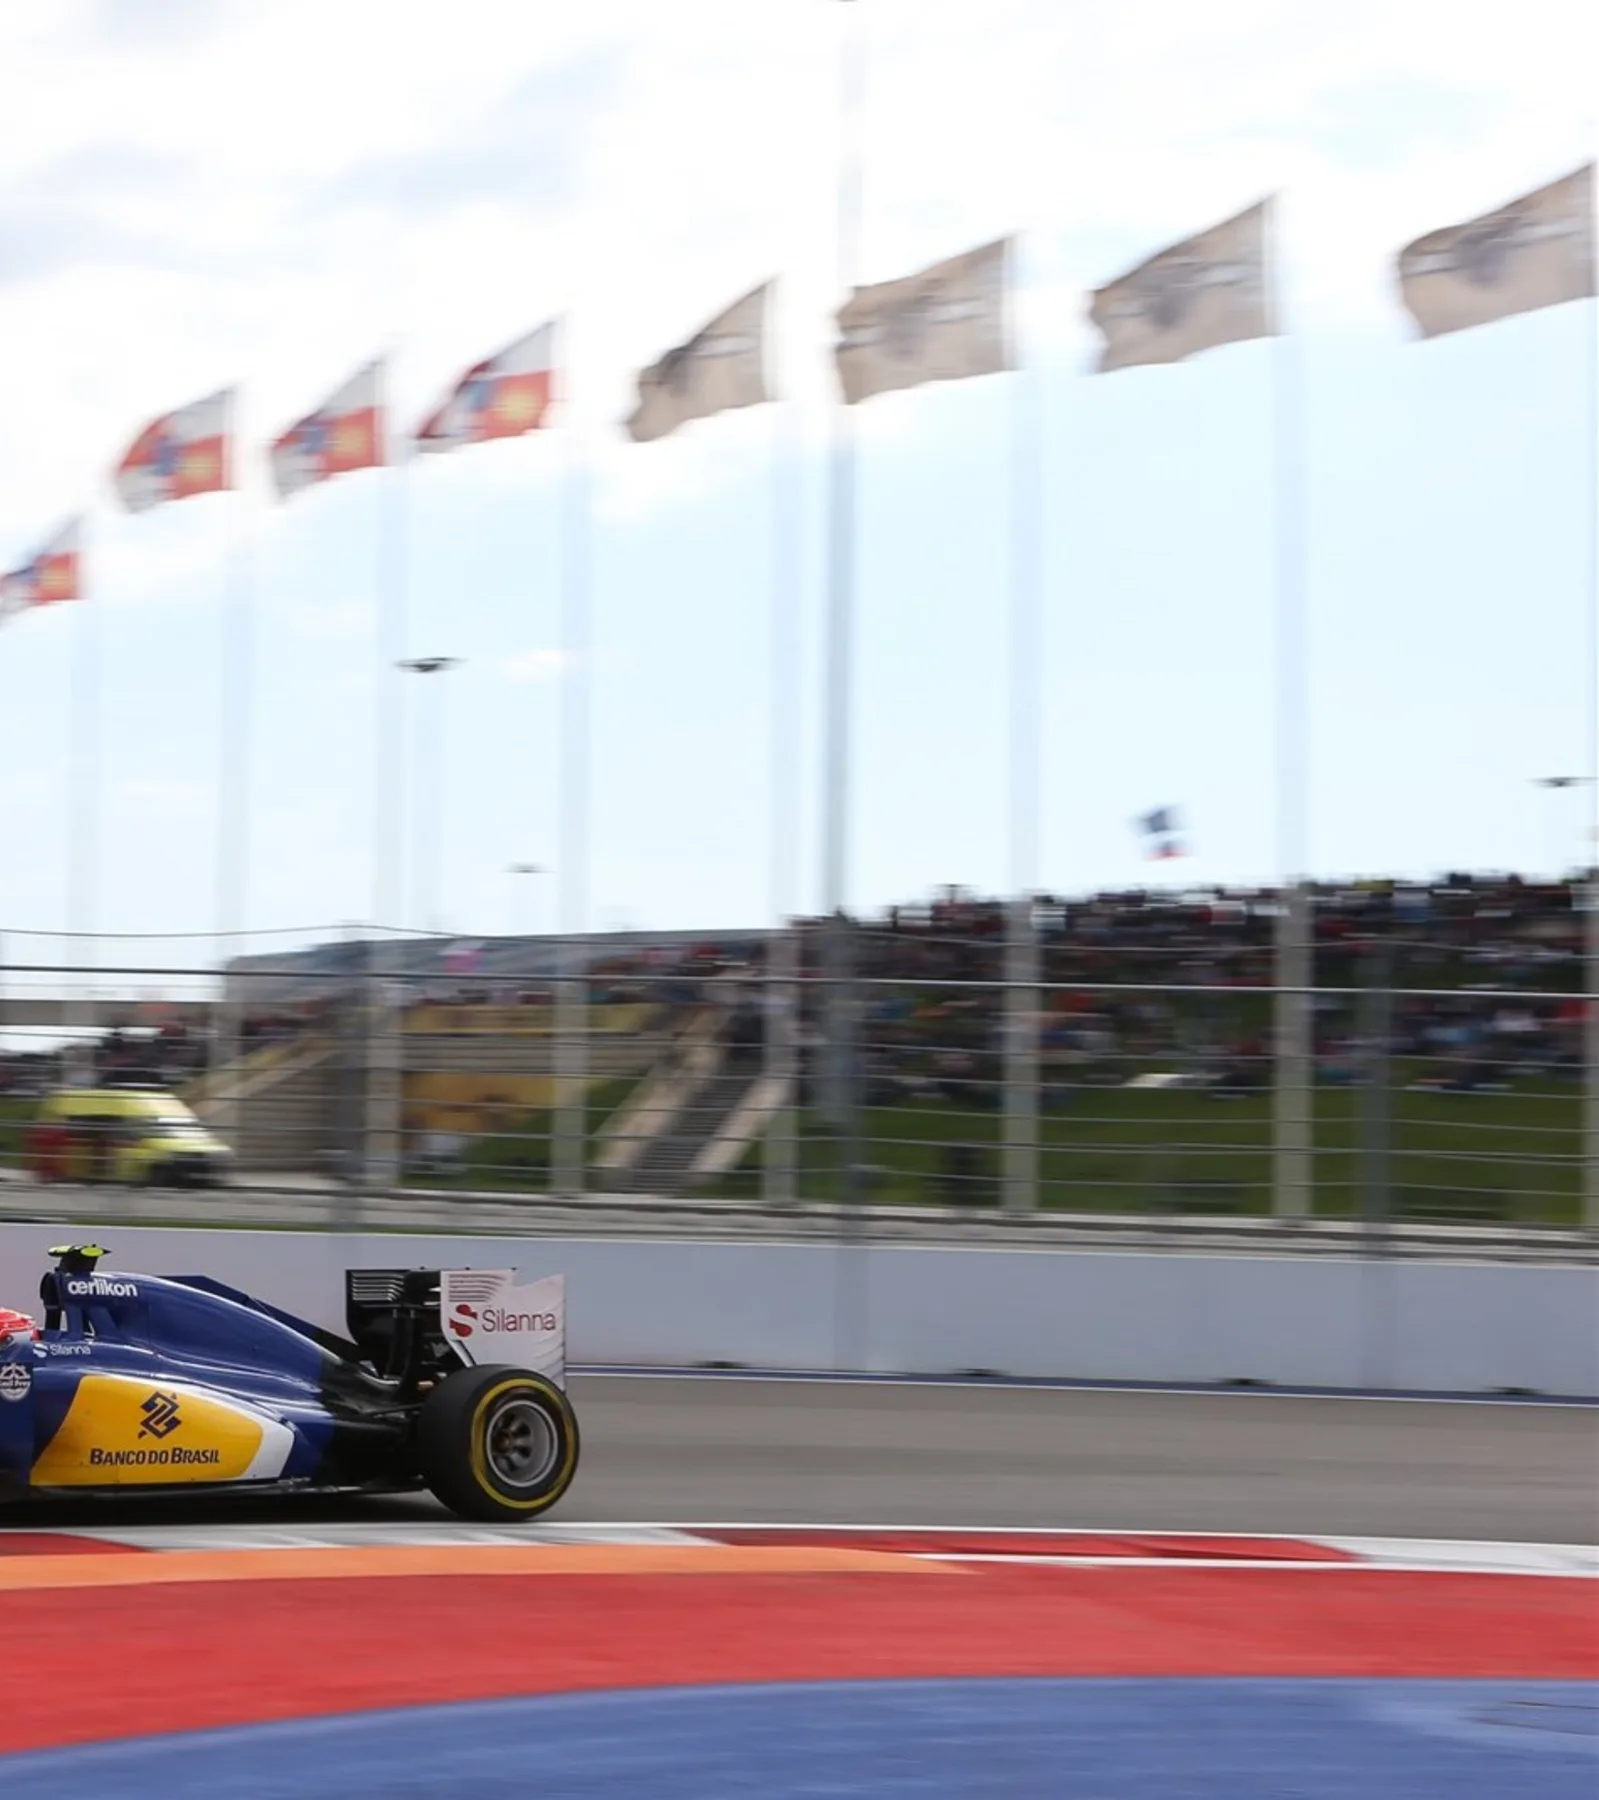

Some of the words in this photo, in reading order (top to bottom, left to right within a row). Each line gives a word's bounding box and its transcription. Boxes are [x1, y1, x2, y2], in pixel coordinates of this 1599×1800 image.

[482, 1308, 556, 1332] Silanna
[90, 1448, 146, 1466] BANCO
[148, 1450, 169, 1465] DO
[171, 1447, 220, 1464] BRASIL
